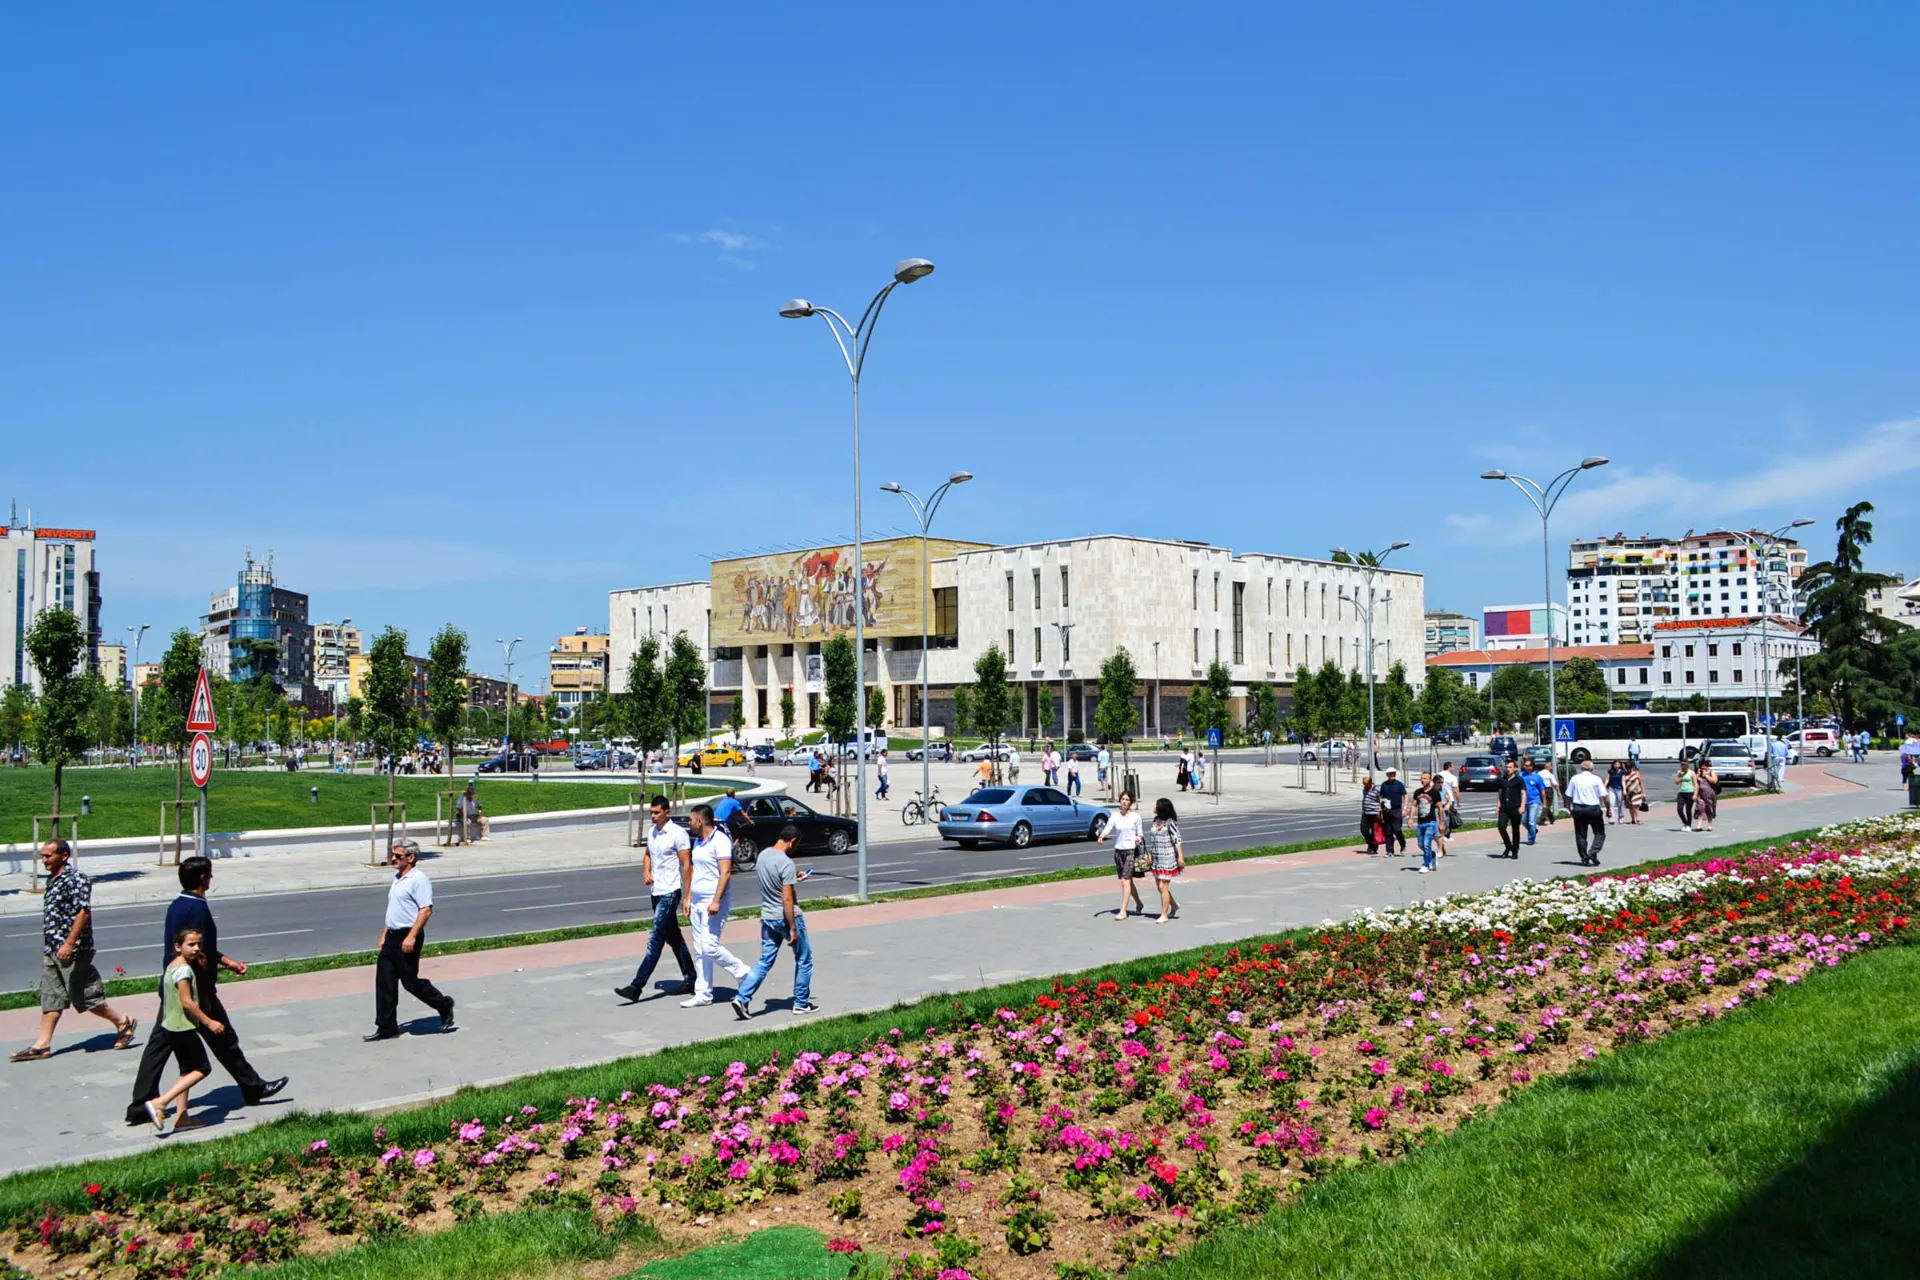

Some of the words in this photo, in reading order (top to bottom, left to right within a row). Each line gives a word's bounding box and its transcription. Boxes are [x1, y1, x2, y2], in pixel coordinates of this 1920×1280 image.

[35, 529, 96, 540] UNIVERSITY
[1699, 617, 1749, 628] UNIVERSITY
[196, 748, 206, 770] 30
